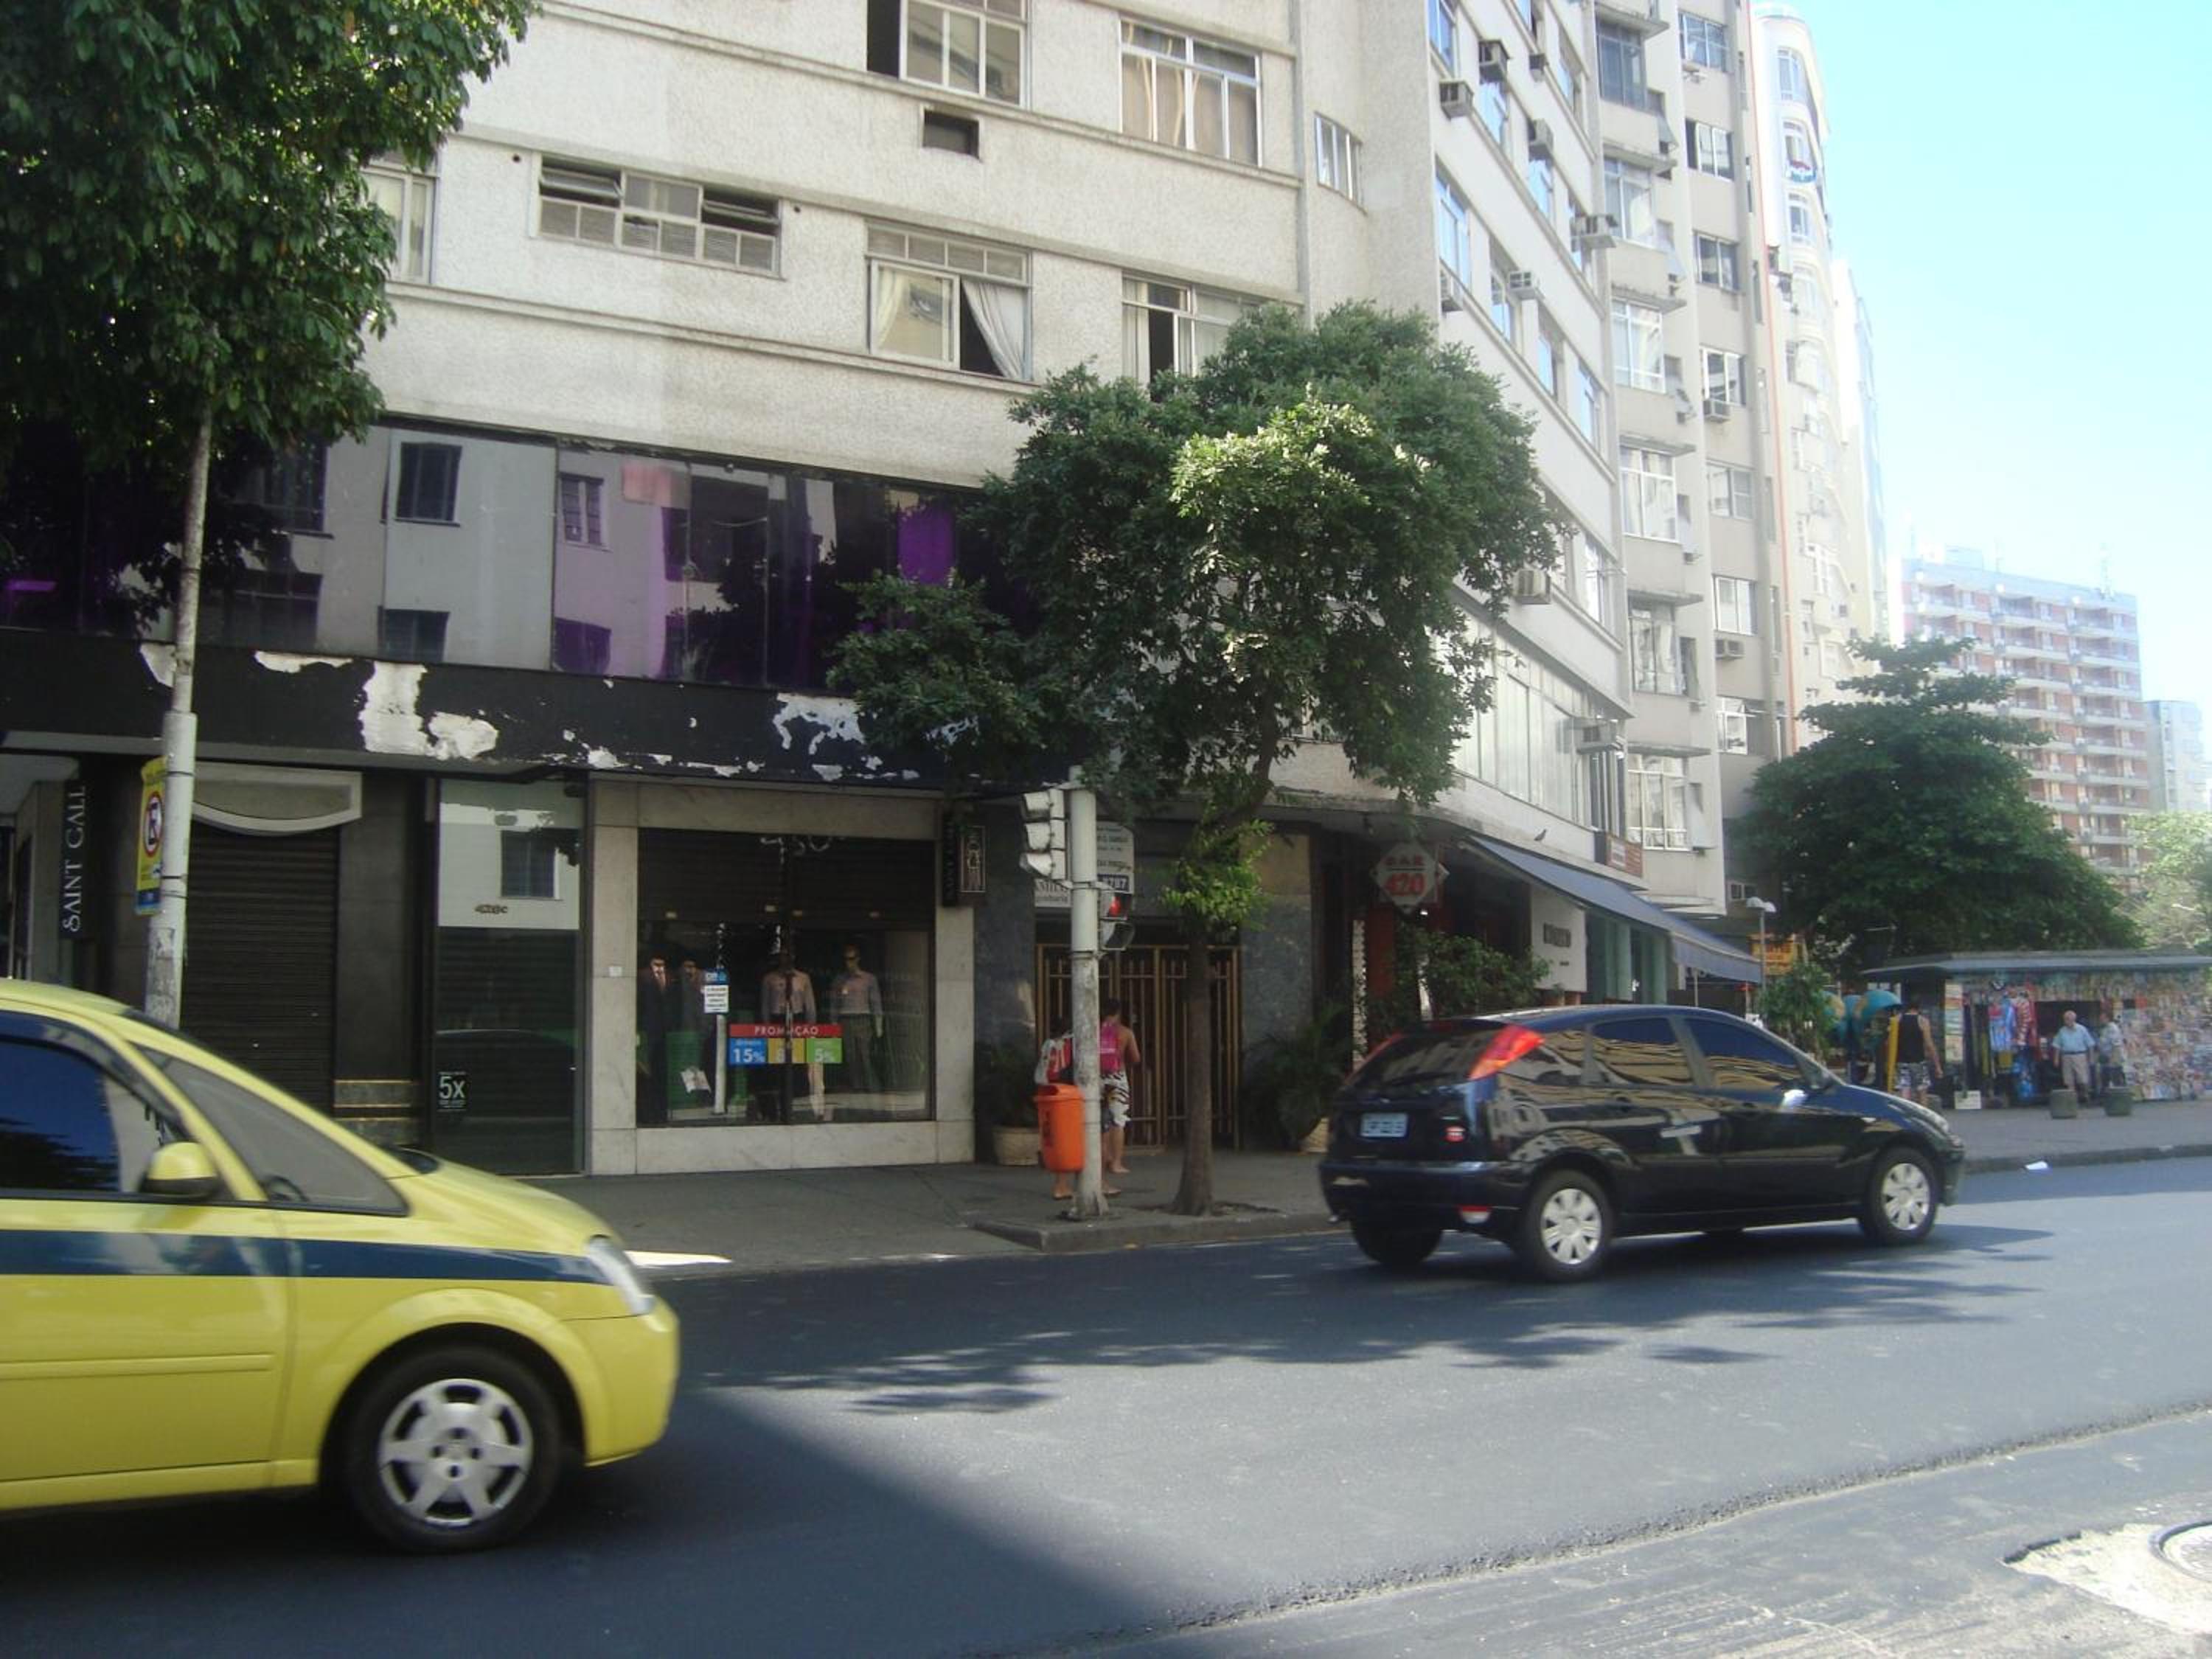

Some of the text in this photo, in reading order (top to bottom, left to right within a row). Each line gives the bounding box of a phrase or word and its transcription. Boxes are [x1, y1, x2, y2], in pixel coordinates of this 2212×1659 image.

[62, 859, 83, 933] SAINT
[755, 1023, 819, 1037] PROMÇÃO
[734, 1047, 766, 1062] 15%
